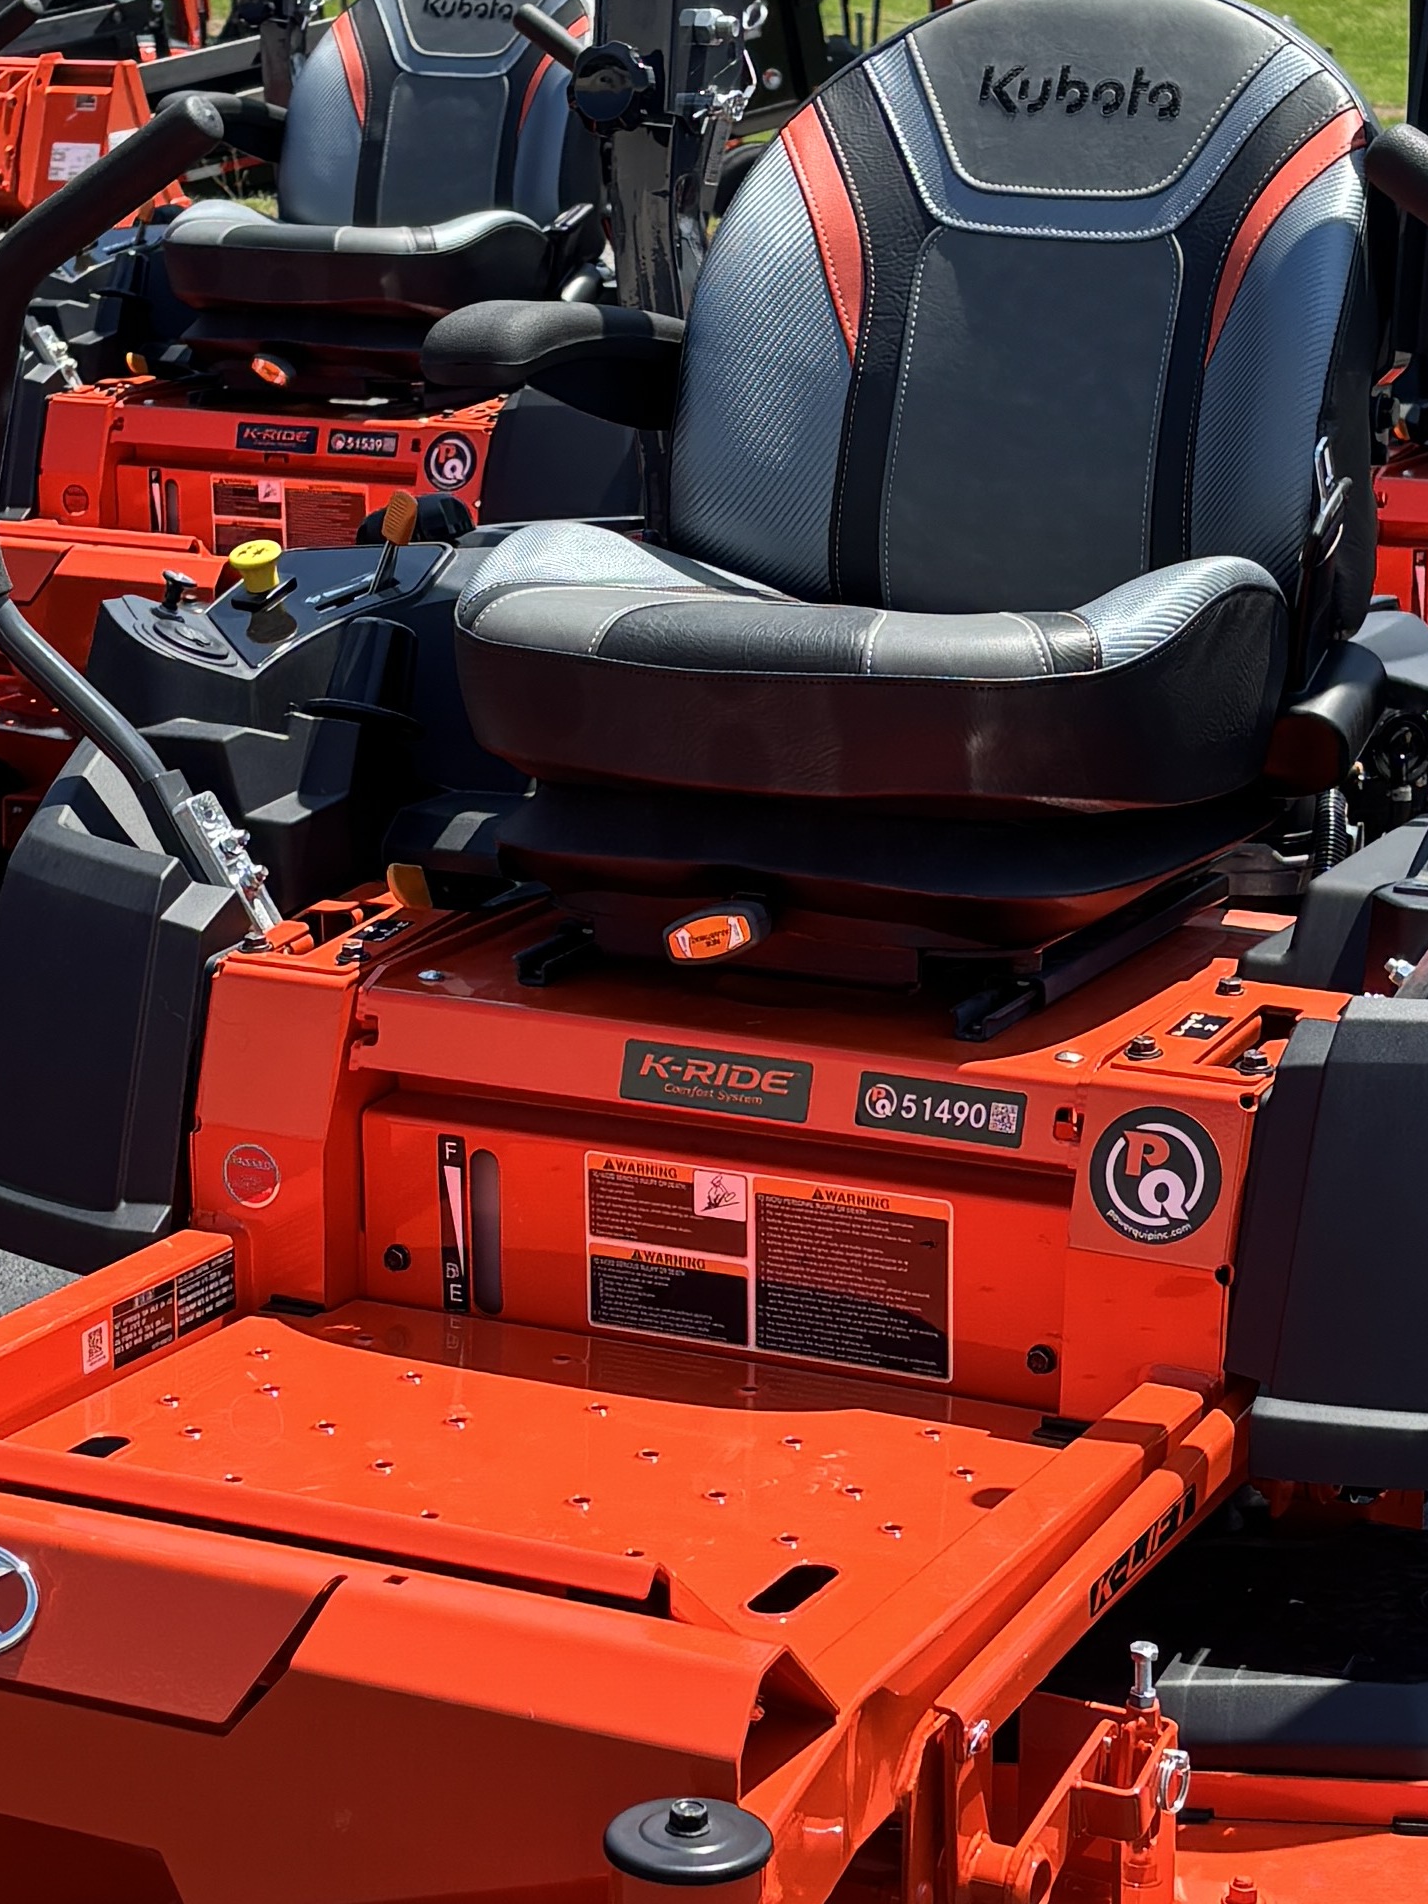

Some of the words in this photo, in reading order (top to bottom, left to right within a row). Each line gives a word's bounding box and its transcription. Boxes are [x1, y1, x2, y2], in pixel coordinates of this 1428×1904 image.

[978, 64, 1183, 119] Kubota
[243, 426, 311, 444] K-RIDE
[639, 1053, 796, 1096] K-RIDE
[663, 1082, 714, 1099] Comfort
[717, 1089, 763, 1105] System
[900, 1094, 987, 1130] 51490
[444, 1141, 458, 1160] F
[616, 1159, 678, 1180] WARNING
[824, 1189, 890, 1210] WARNING
[1106, 1207, 1192, 1242] powerquipinc.com
[643, 1249, 706, 1271] WARNING
[449, 1283, 464, 1303] E
[1093, 1487, 1193, 1613] K-LIFT
